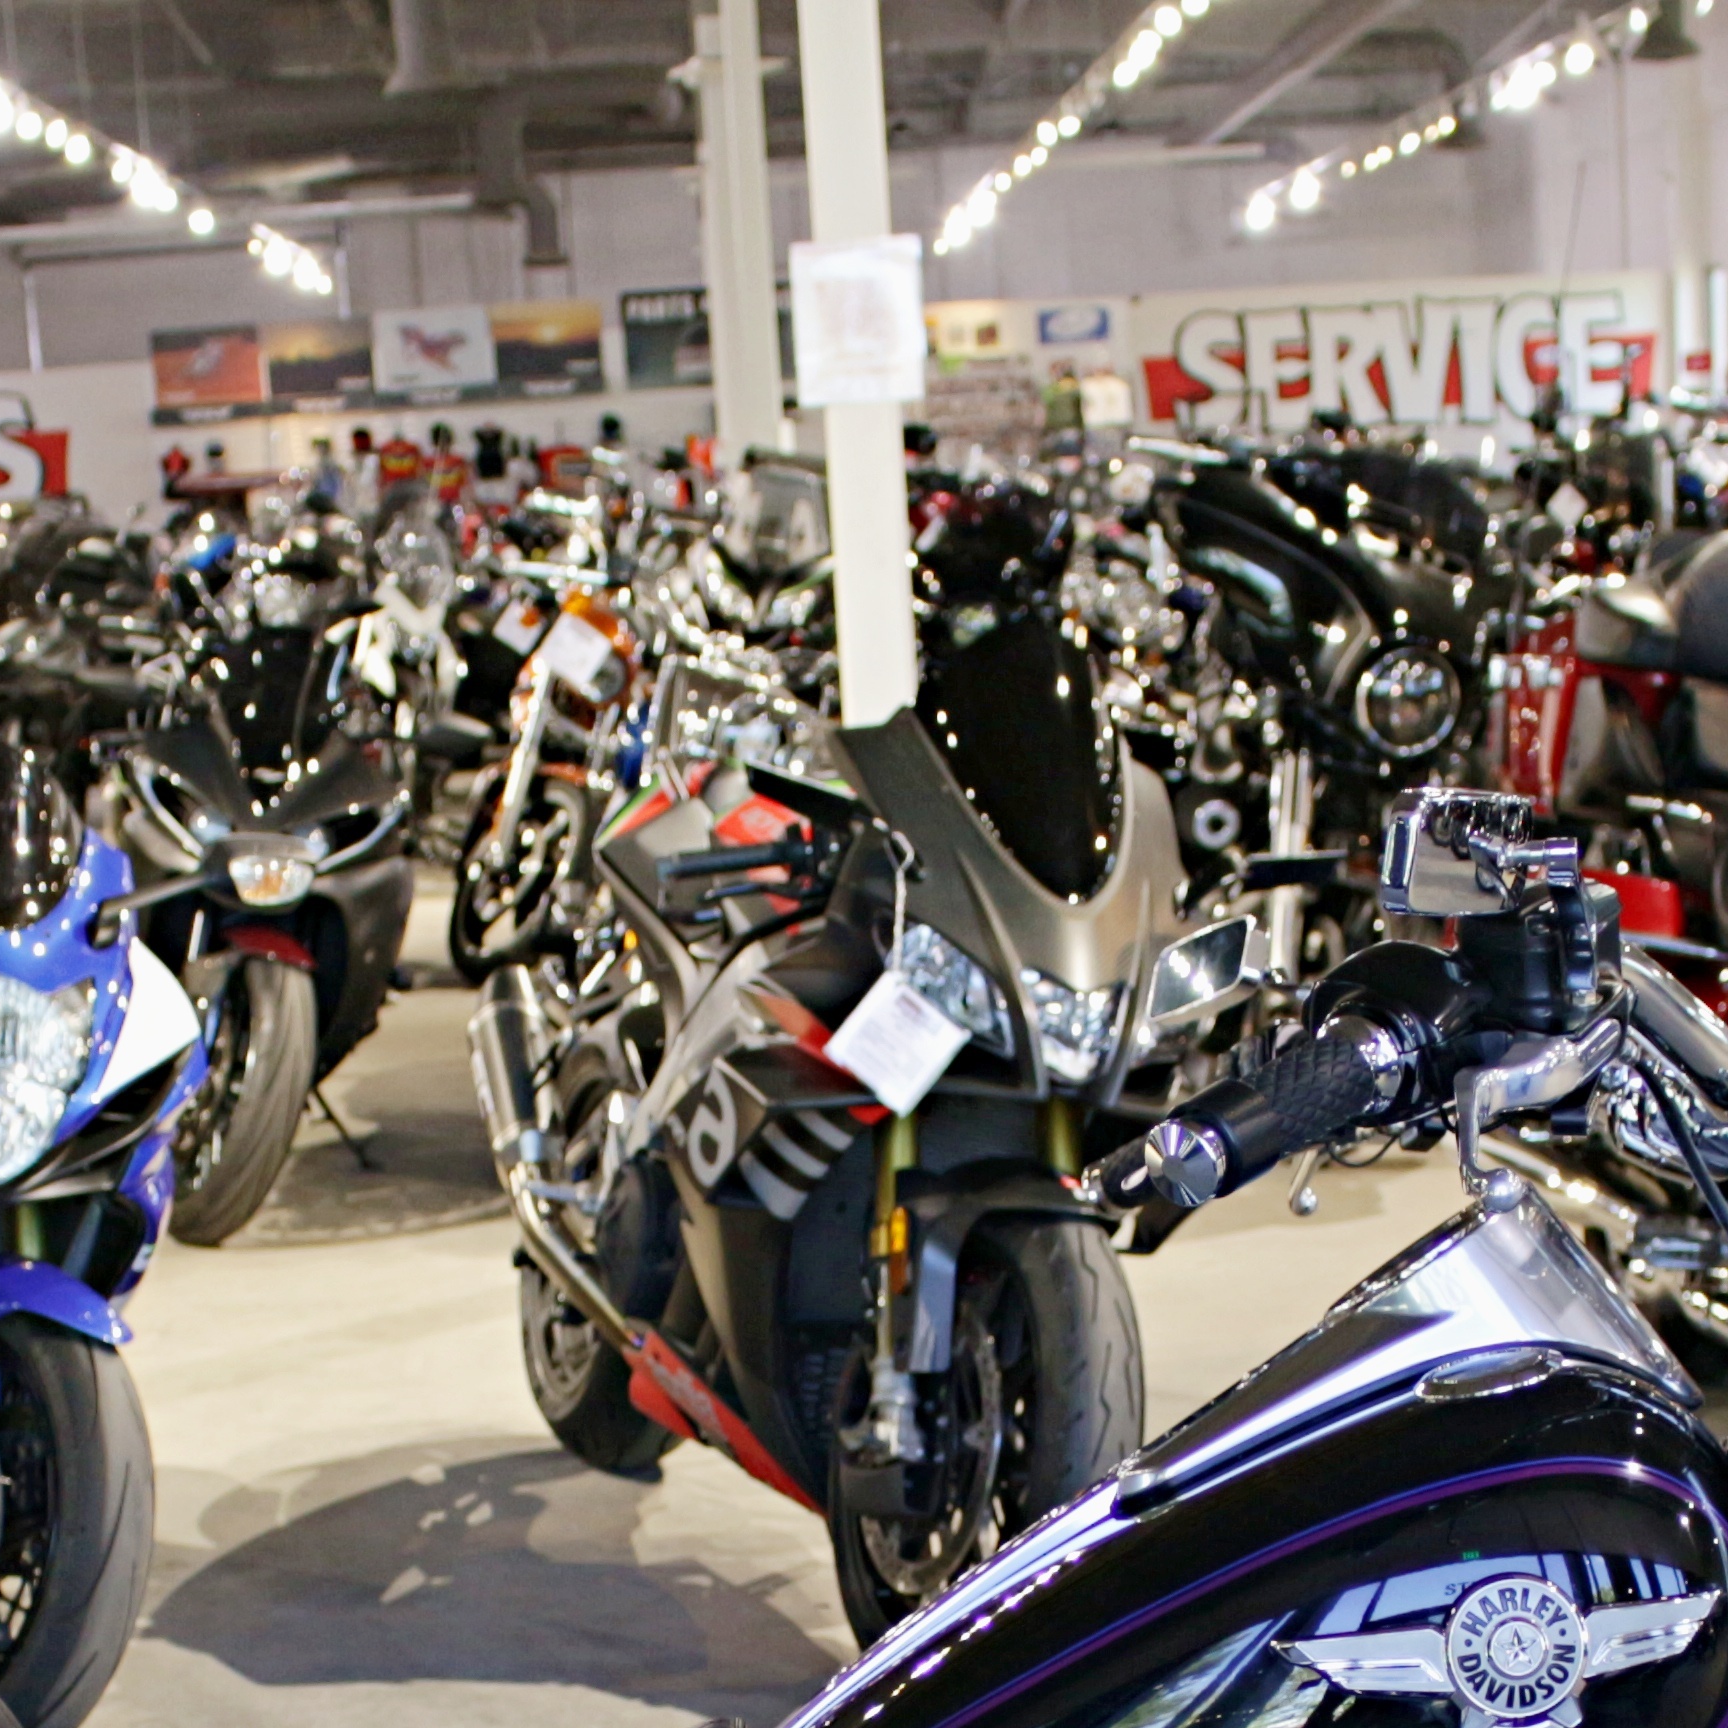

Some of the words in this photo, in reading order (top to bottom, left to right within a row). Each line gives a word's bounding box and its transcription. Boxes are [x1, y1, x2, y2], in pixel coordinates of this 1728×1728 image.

[1174, 290, 1624, 434] SERVICE
[1460, 1587, 1569, 1637] HARLEY
[1457, 1643, 1576, 1708] DAVIDSON
